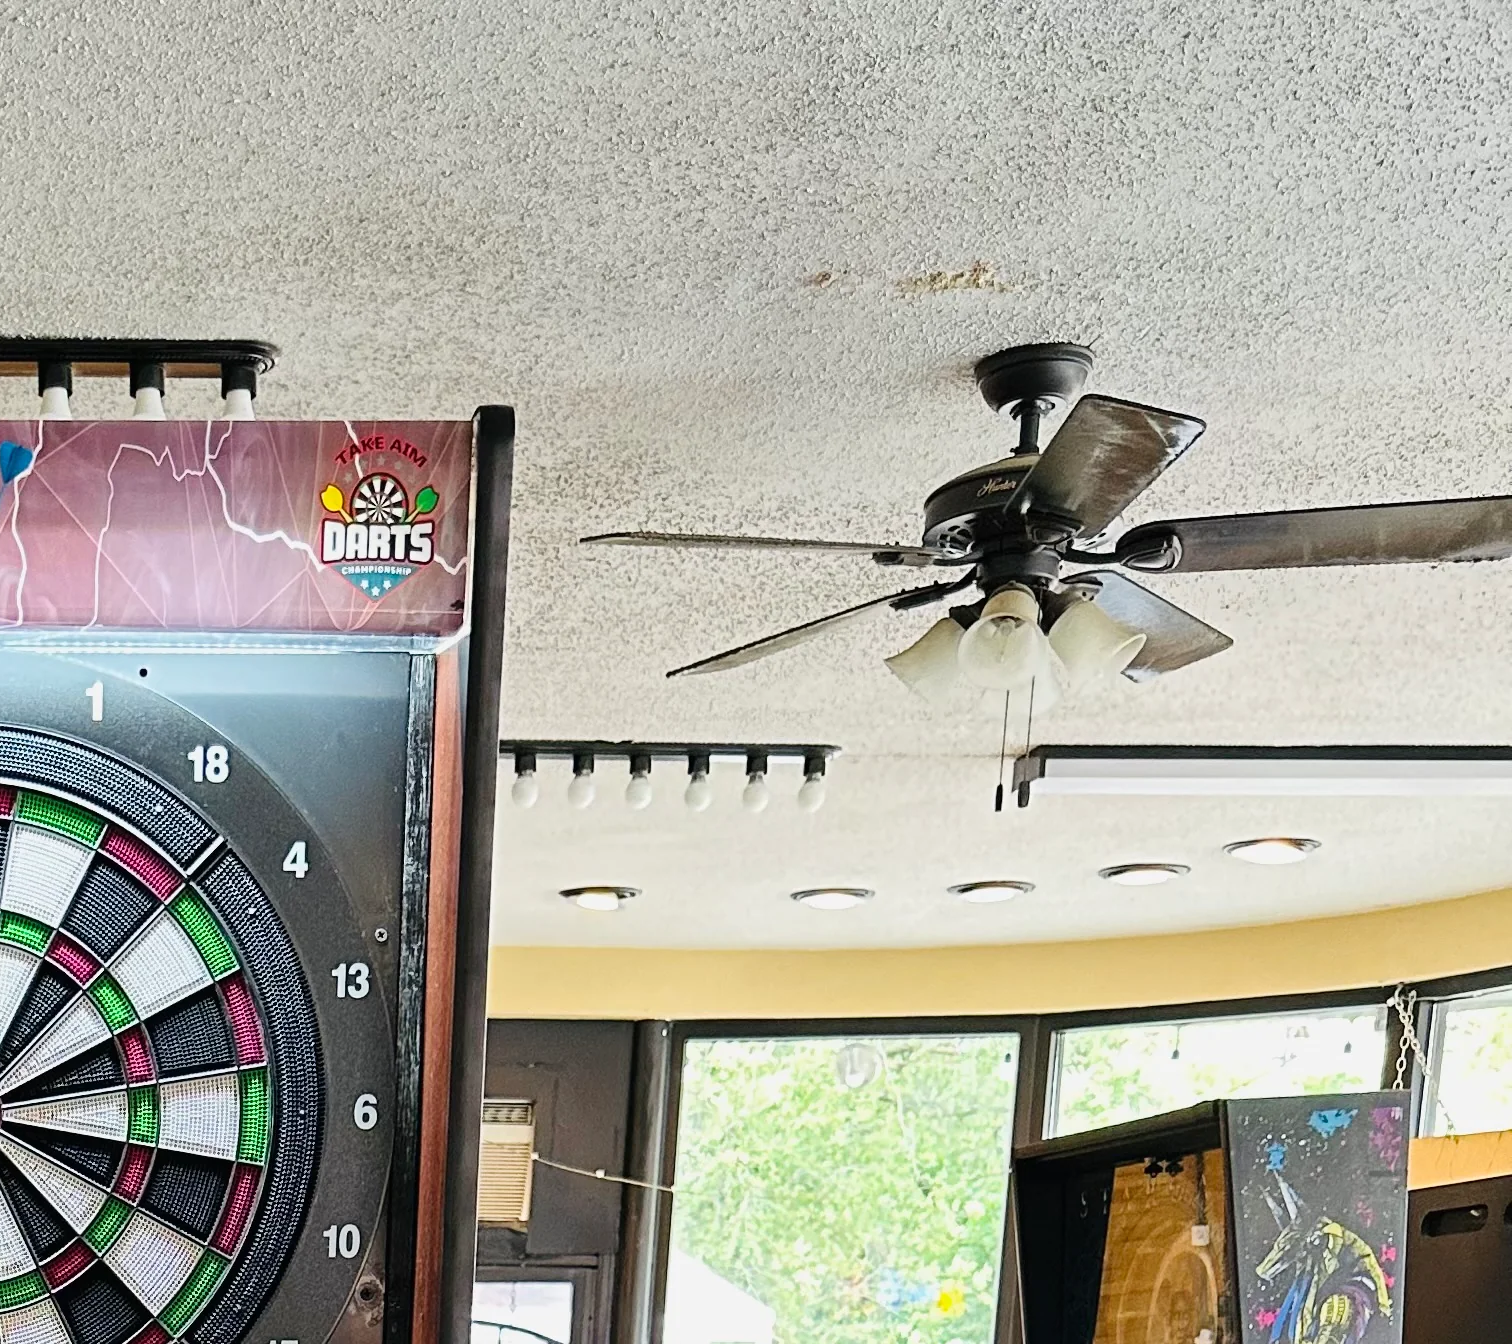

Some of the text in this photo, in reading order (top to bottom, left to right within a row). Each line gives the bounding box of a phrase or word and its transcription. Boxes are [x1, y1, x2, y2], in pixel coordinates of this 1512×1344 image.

[334, 436, 428, 468] TAKE AIM
[322, 520, 433, 563] DARTS
[341, 565, 412, 576] CHAMPIONSHIP
[84, 682, 106, 721] 1
[187, 744, 229, 784] 18
[282, 841, 309, 879] 4
[331, 962, 370, 999] 13
[353, 1093, 378, 1130] 6
[322, 1223, 361, 1259] 10
